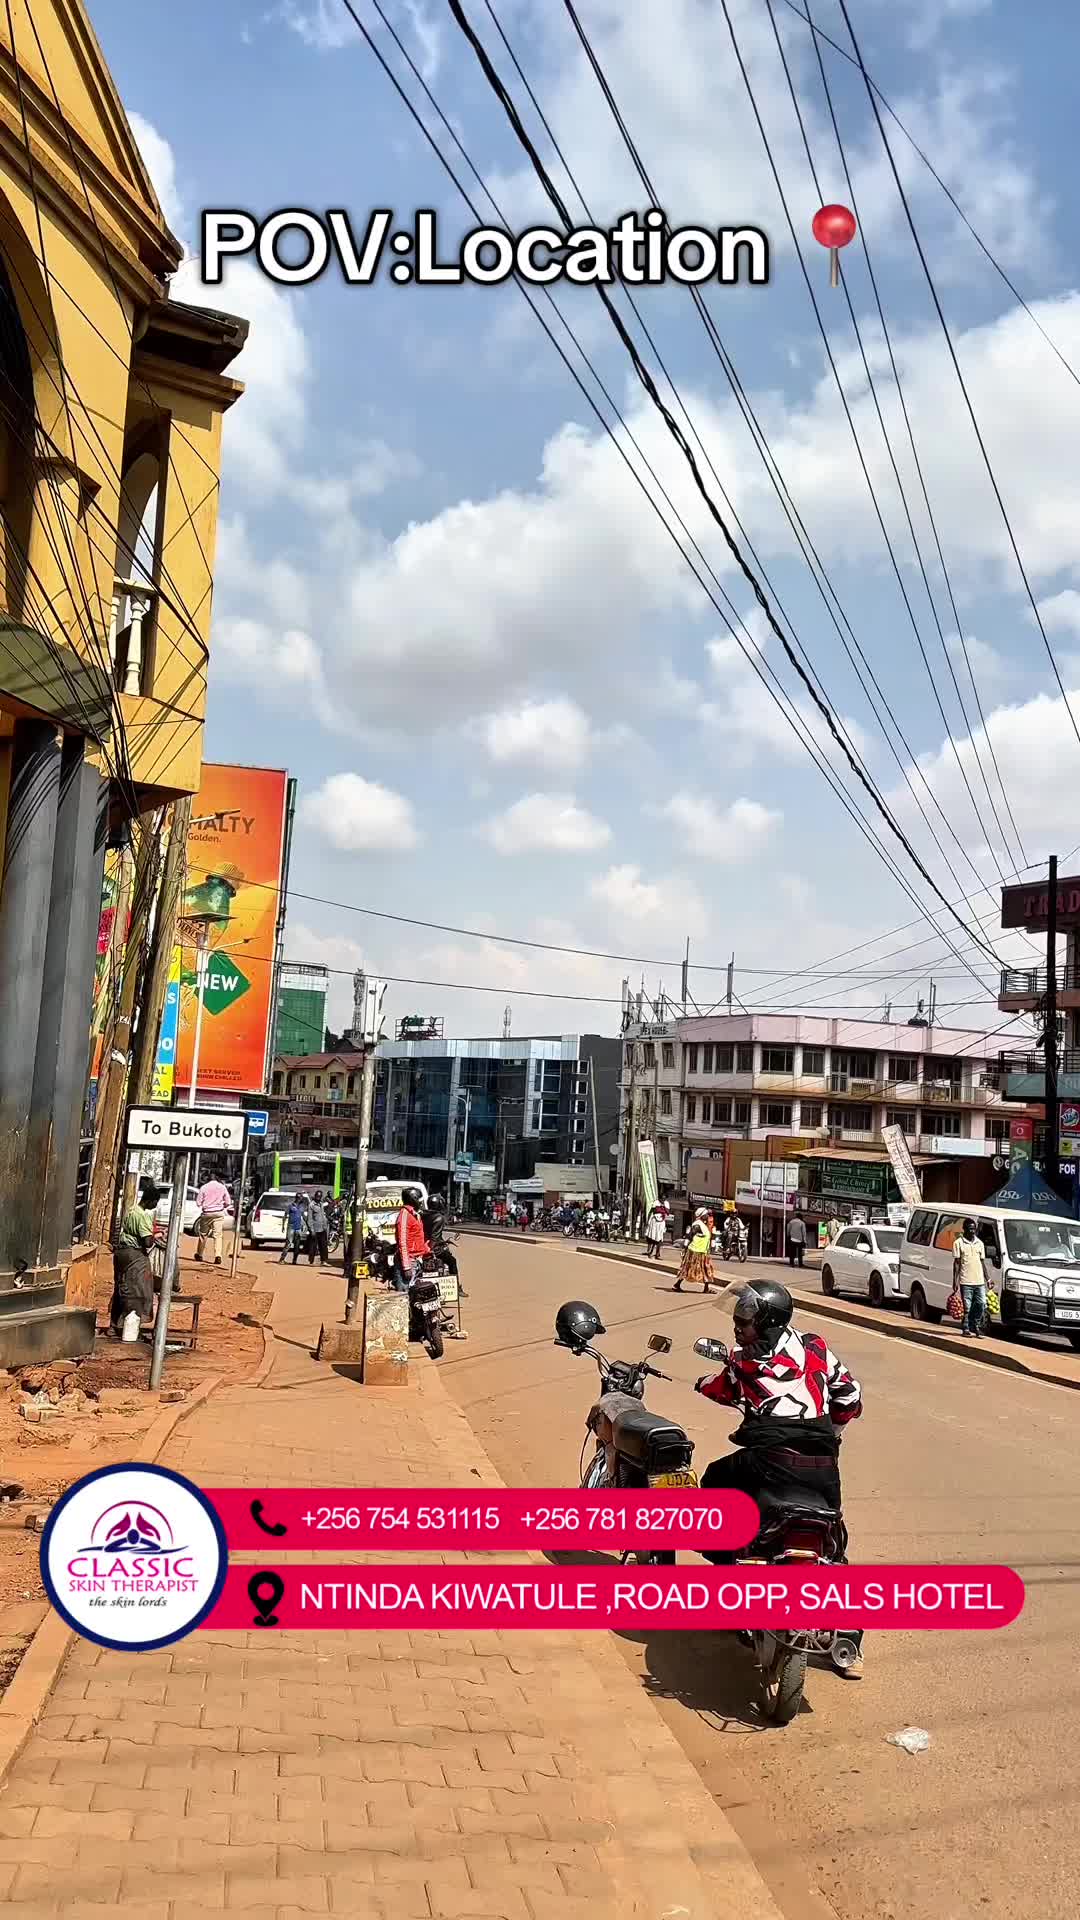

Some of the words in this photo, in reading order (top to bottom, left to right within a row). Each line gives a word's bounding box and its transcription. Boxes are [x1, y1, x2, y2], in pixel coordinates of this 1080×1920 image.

[188, 832, 222, 843] Golden.
[197, 972, 239, 992] NEW
[141, 1119, 161, 1135] To
[169, 1121, 231, 1139] Bukoto
